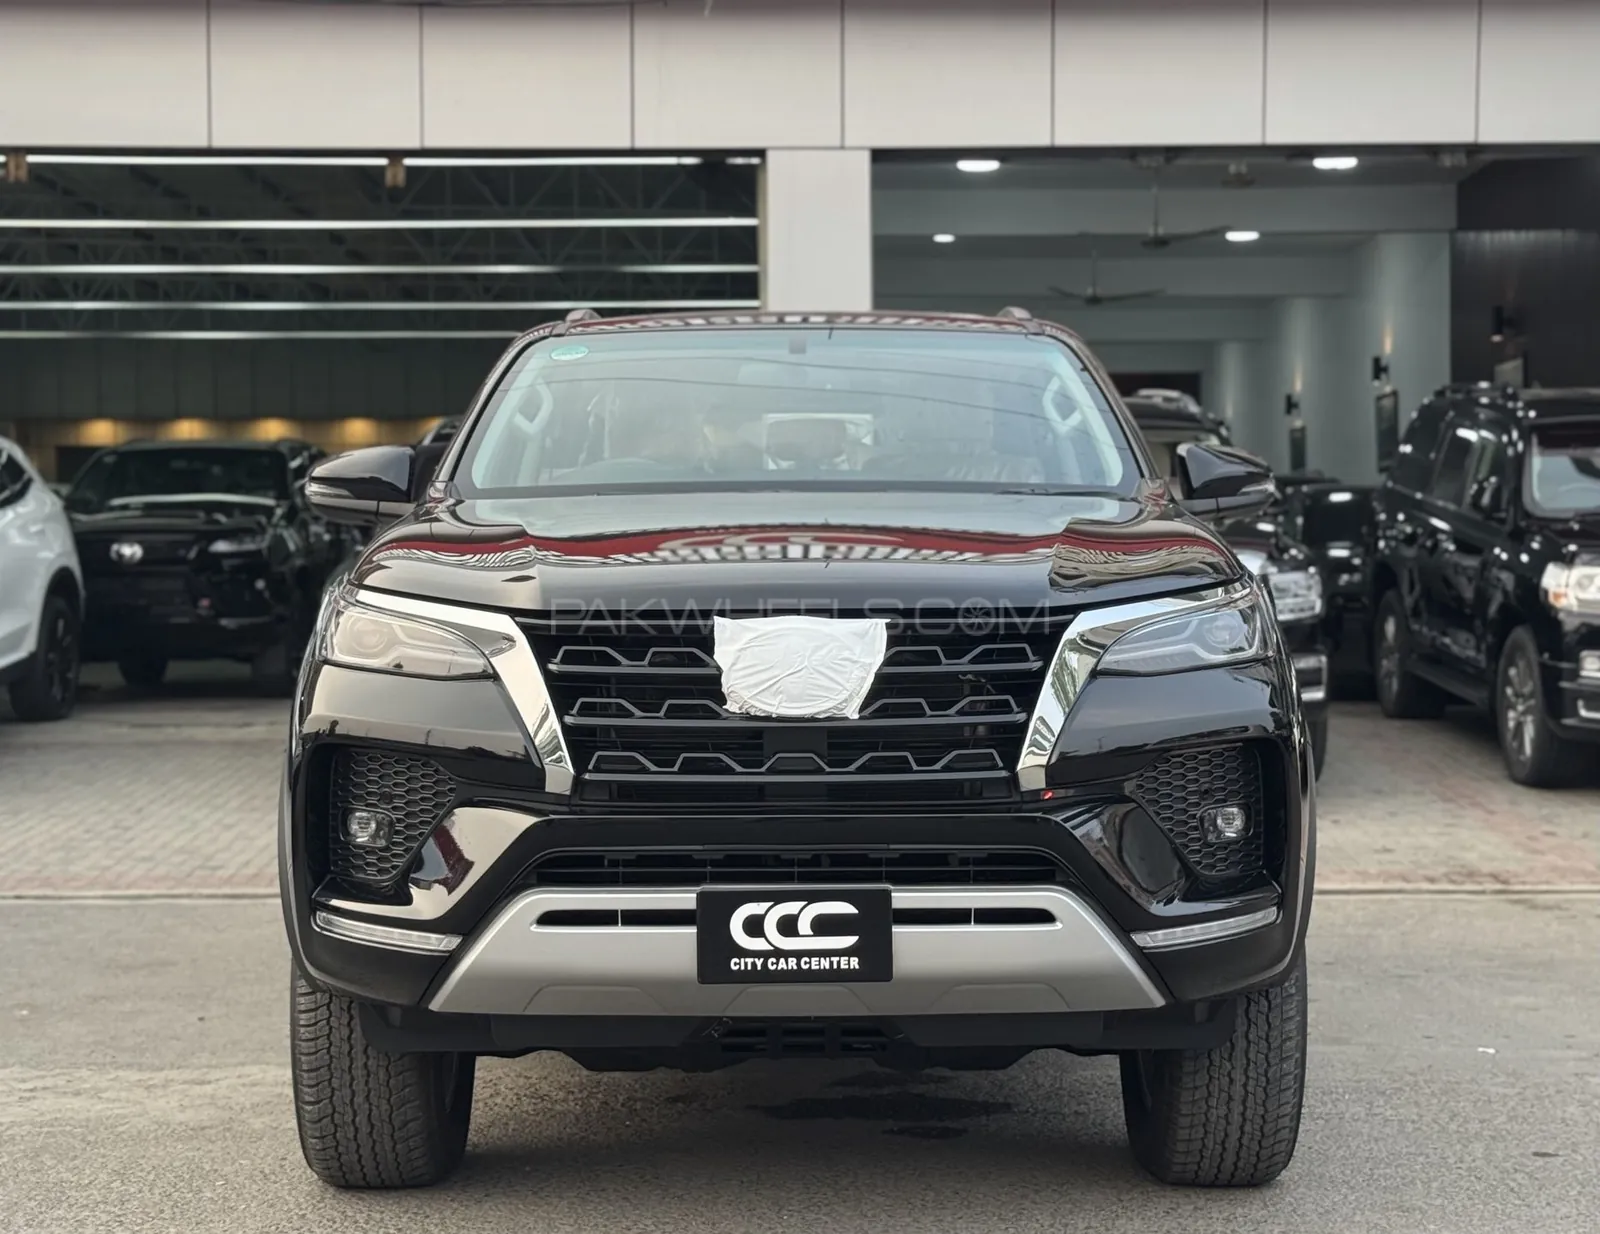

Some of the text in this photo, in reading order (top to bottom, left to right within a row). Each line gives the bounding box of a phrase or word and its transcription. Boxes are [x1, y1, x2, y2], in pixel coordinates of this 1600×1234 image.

[730, 956, 860, 971] CITY CAR CENTER
